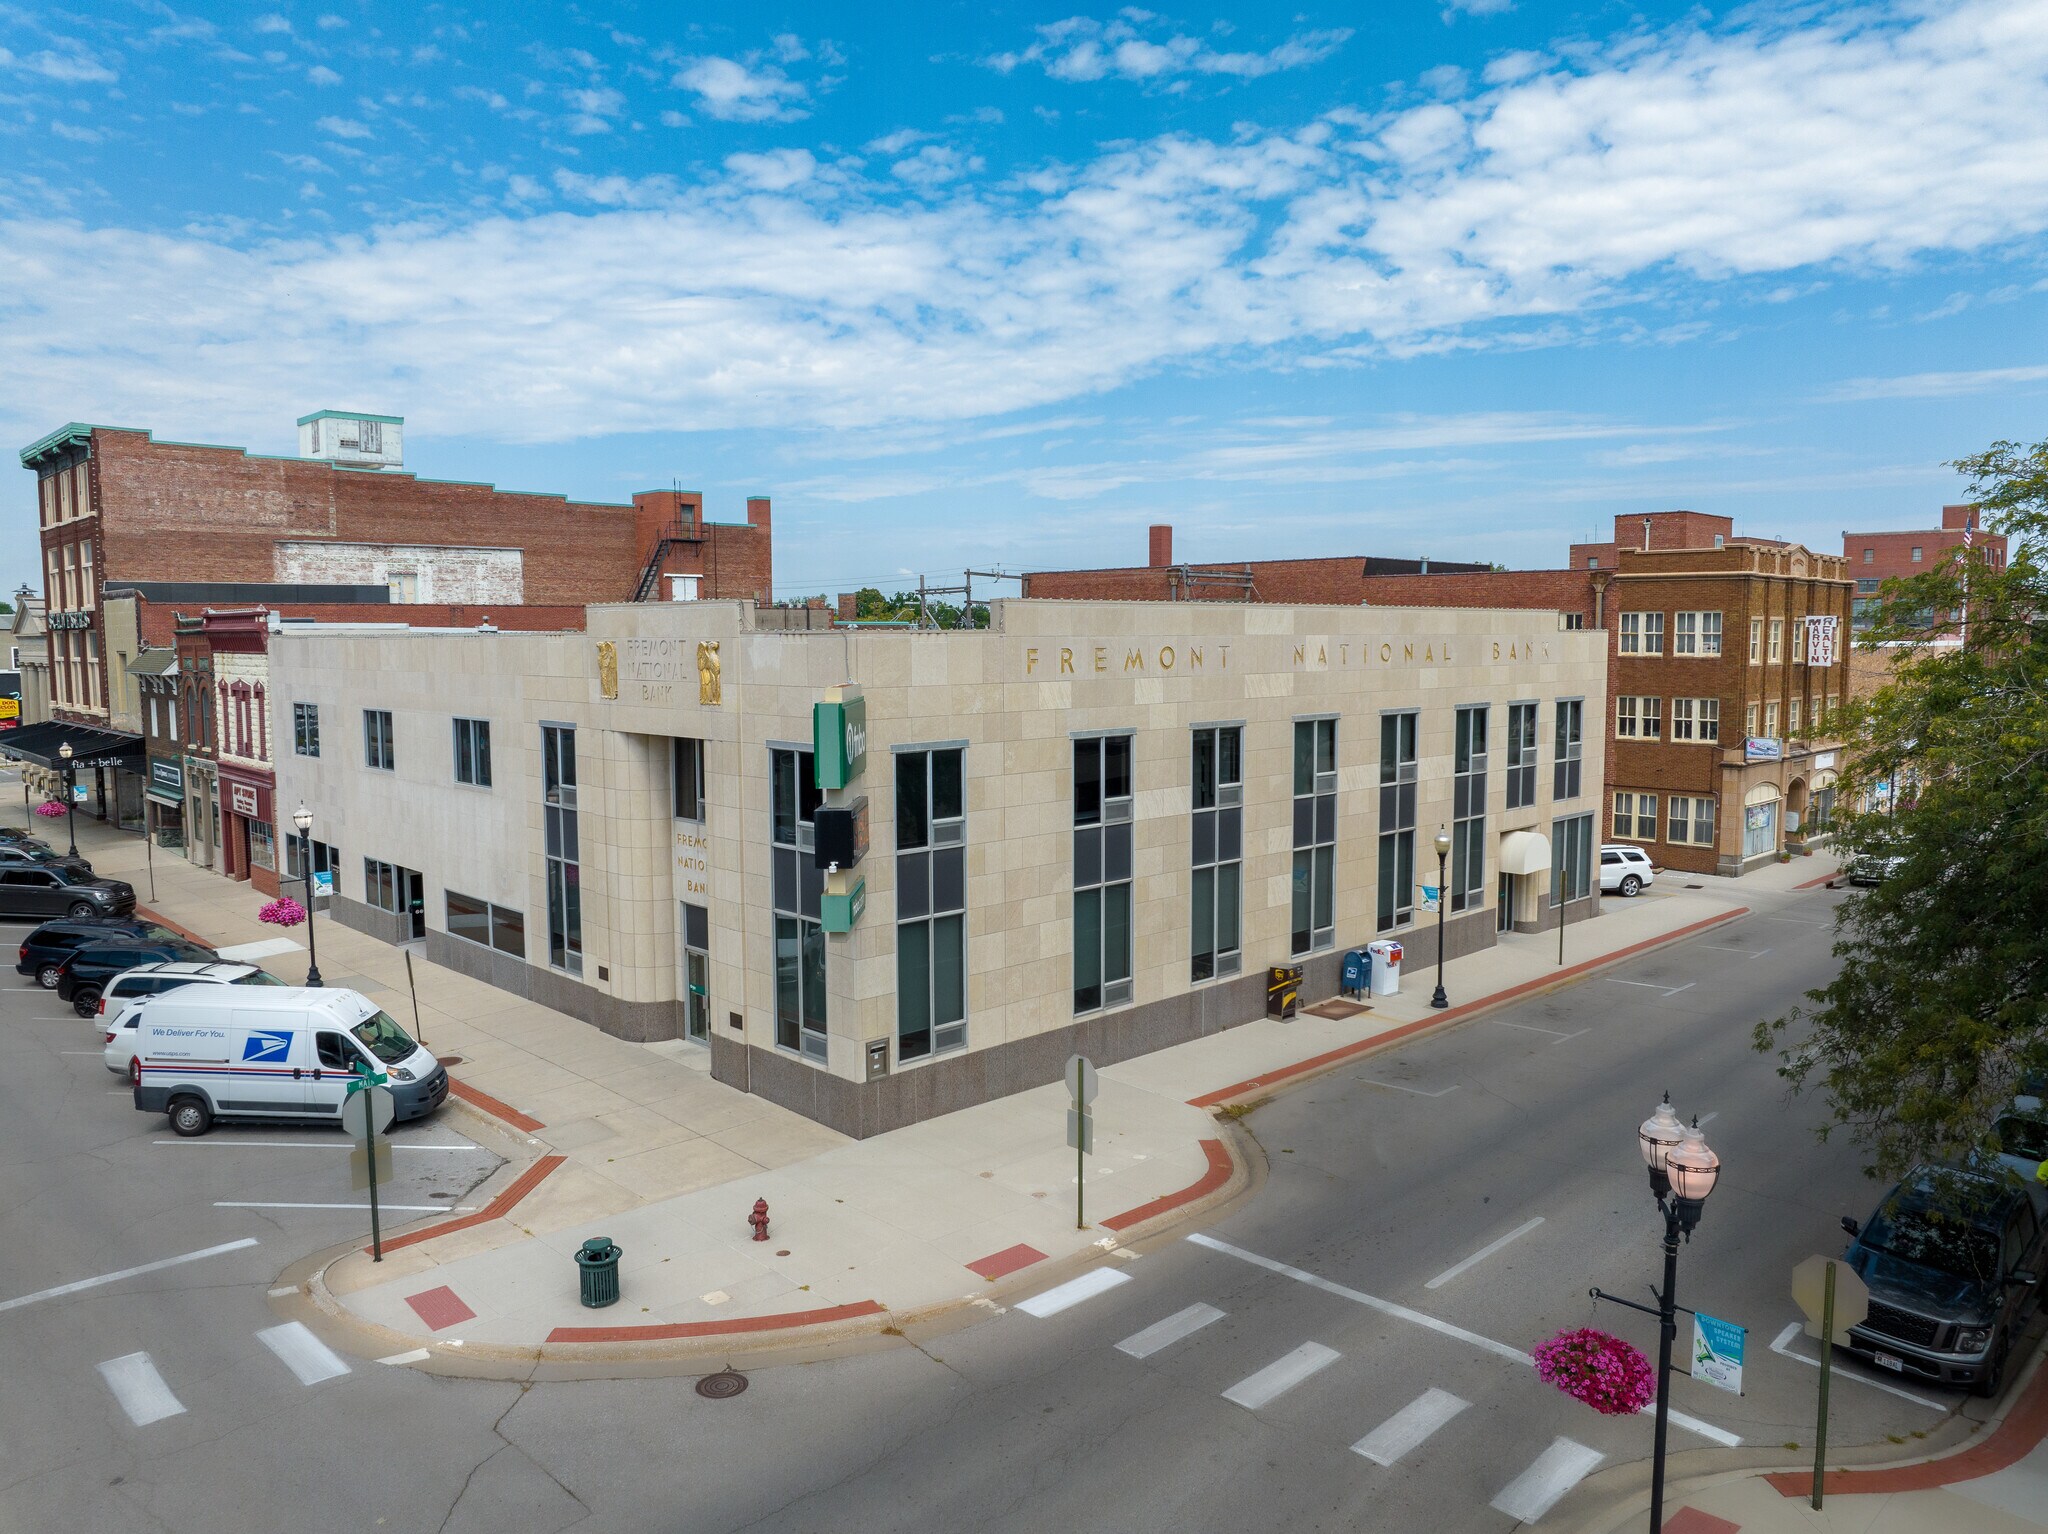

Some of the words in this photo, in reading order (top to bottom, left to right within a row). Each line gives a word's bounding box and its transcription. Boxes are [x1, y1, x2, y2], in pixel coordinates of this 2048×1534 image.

[627, 639, 687, 657] FREMONT
[1808, 618, 1821, 663] MARVIN
[1822, 617, 1834, 663] REALTY
[1026, 645, 1231, 674] FREMONT
[1293, 642, 1452, 665] NATIONAL
[1491, 641, 1550, 660] BANK
[627, 662, 688, 680] NATIONAL
[642, 684, 674, 703] BANK
[71, 760, 85, 769] fia
[98, 757, 123, 767] belle
[152, 1028, 165, 1036] We
[166, 1028, 194, 1037] Deliver
[195, 1029, 209, 1038] For
[1701, 1316, 1742, 1335] DOWNTOWN
[1713, 1328, 1741, 1343] SPEAKER
[1716, 1336, 1741, 1350] SYSTEM
